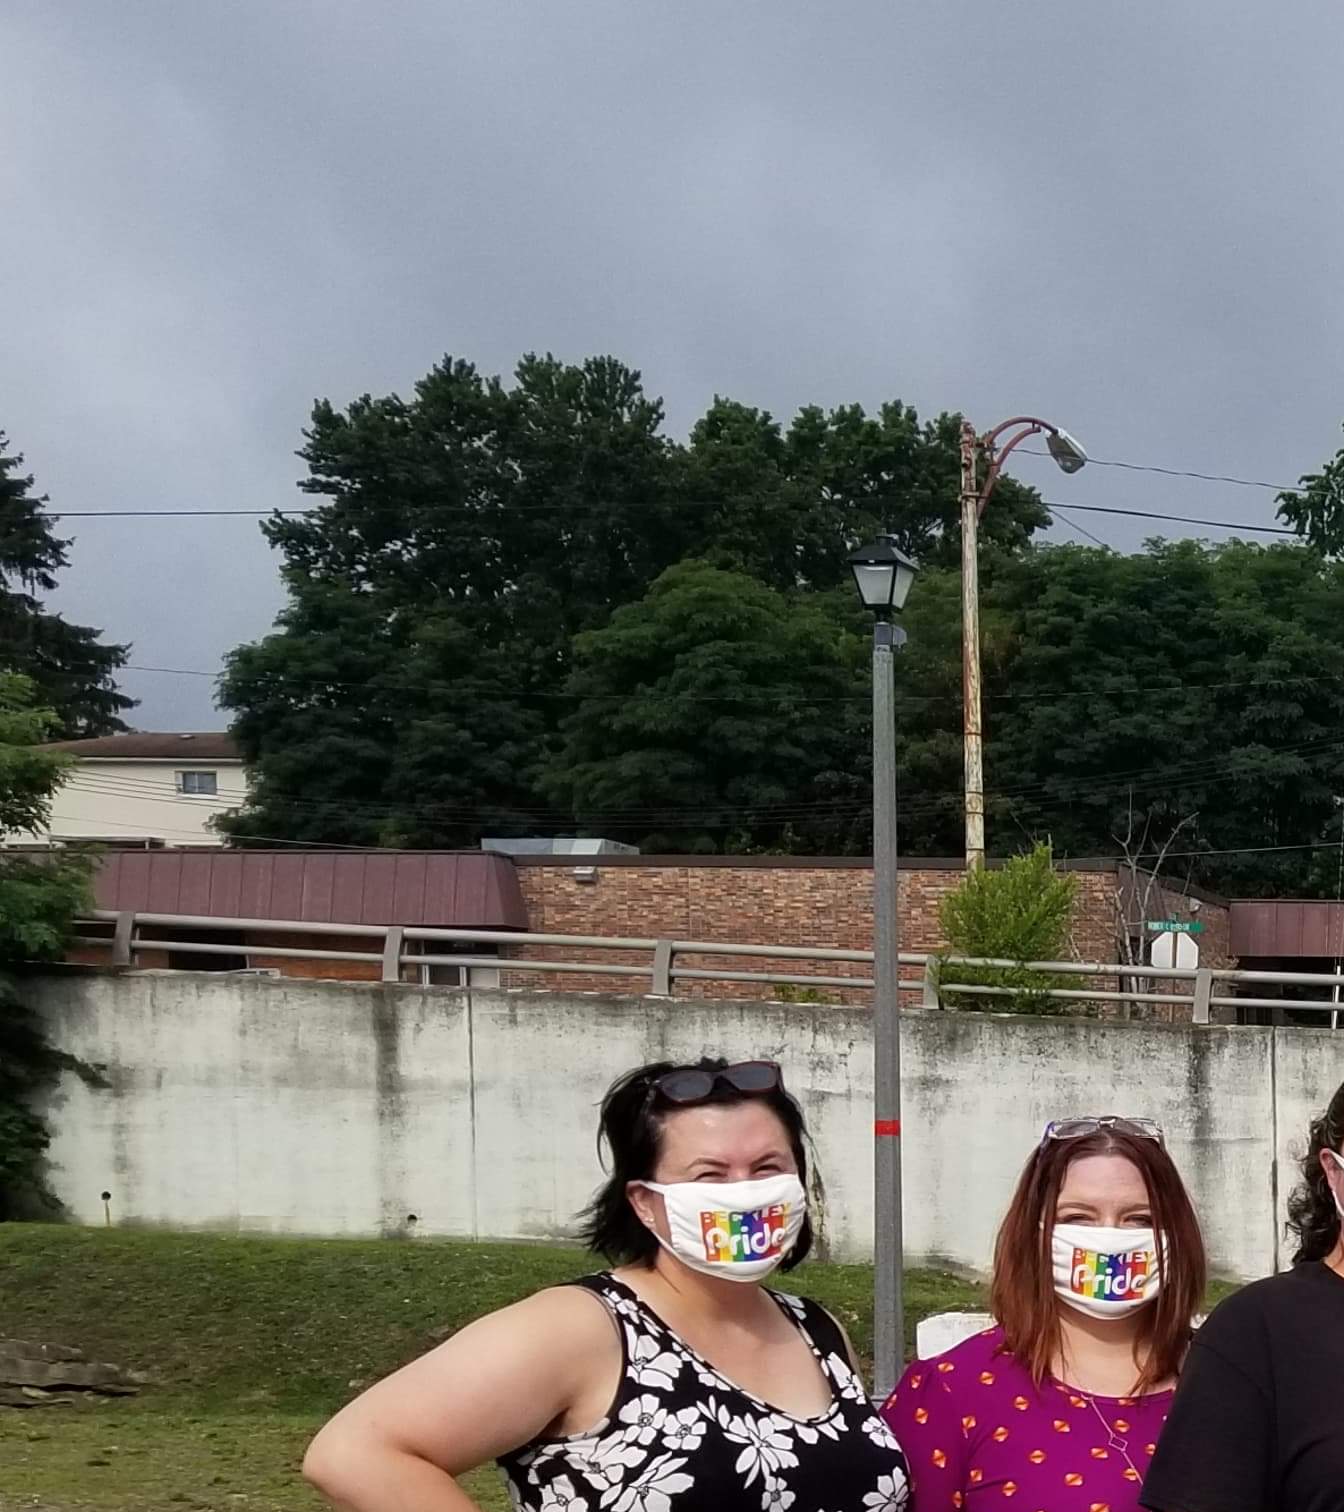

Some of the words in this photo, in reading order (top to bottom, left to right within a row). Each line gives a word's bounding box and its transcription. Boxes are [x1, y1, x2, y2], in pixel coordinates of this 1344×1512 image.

[700, 1202, 791, 1224] BECKLEY
[705, 1223, 786, 1255] Pride
[1073, 1264, 1148, 1295] Pride
